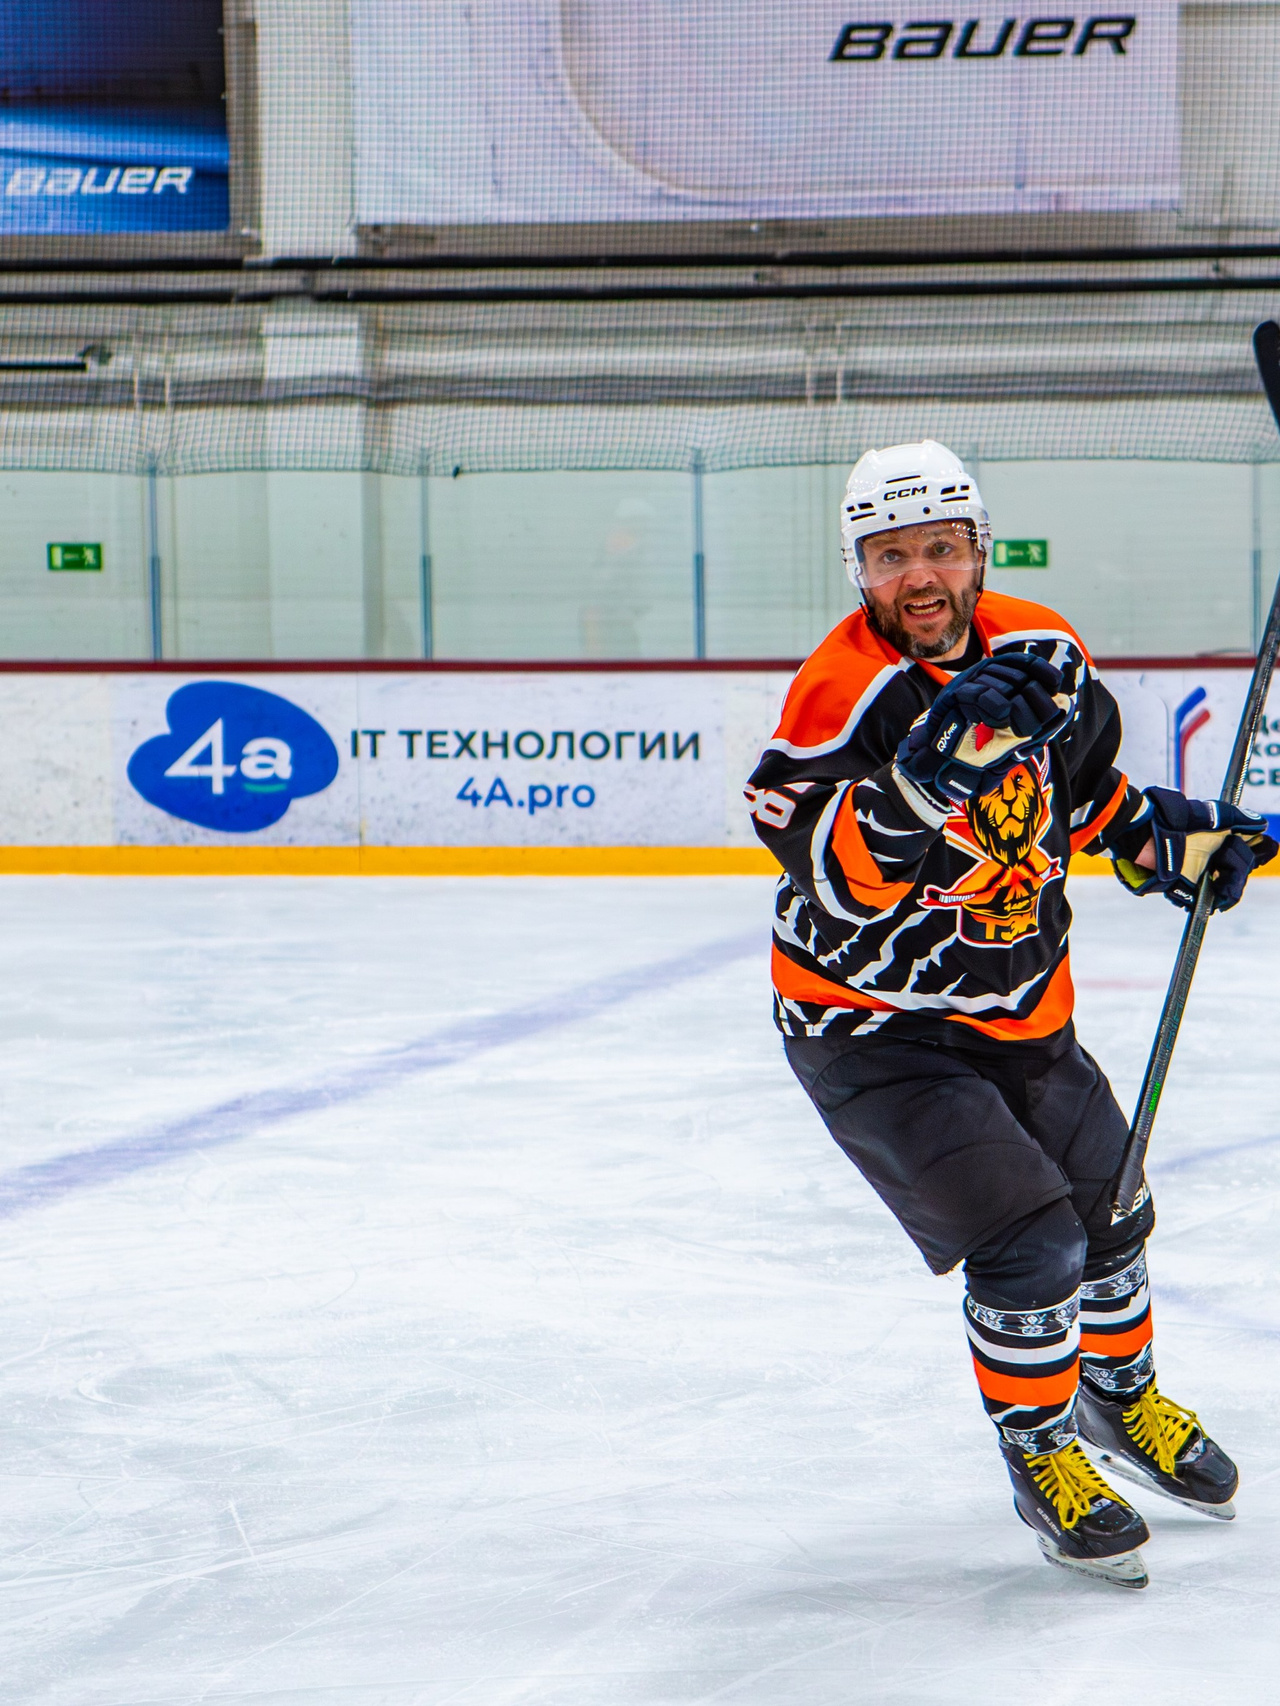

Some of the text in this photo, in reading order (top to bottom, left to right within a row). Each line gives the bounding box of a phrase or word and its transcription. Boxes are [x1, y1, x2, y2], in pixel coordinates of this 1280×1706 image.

[883, 485, 928, 501] CCM
[351, 730, 700, 760] IT ТЕХНОЛОГИИ
[456, 777, 596, 815] 4A.pro
